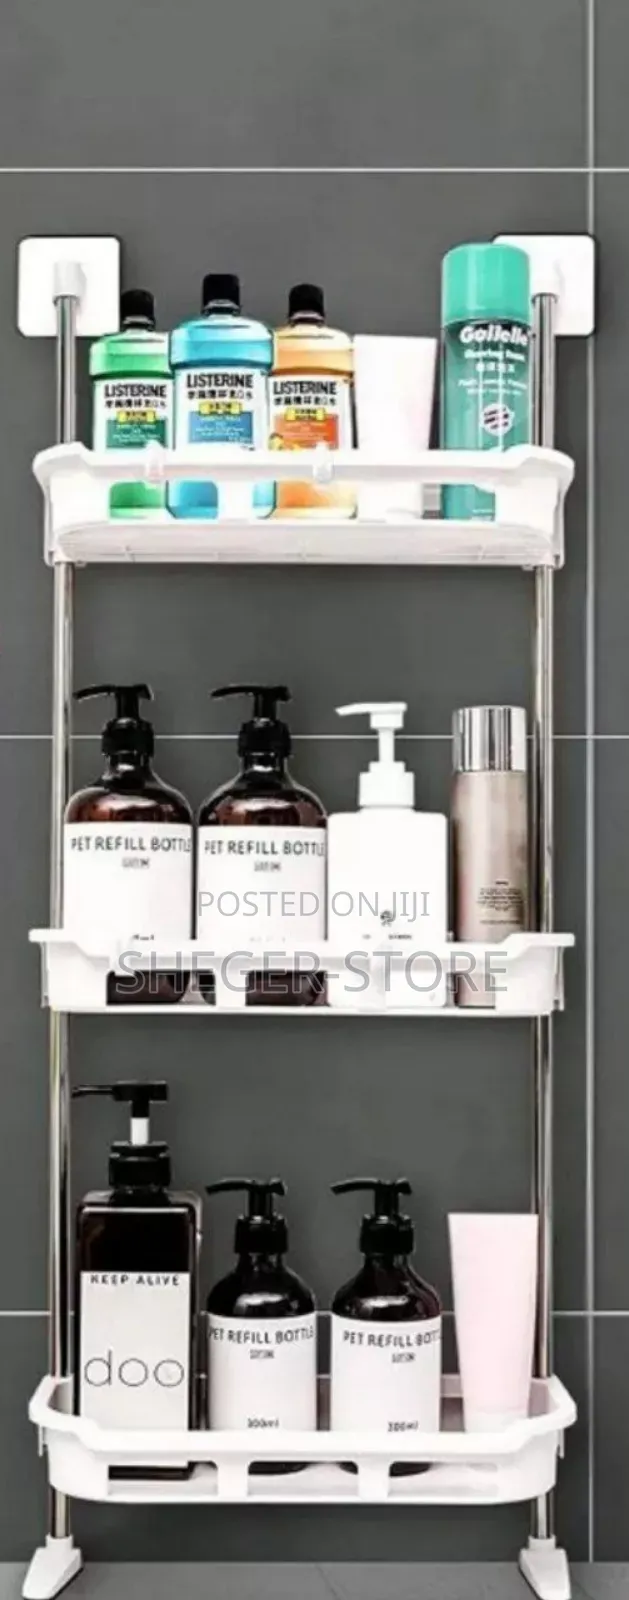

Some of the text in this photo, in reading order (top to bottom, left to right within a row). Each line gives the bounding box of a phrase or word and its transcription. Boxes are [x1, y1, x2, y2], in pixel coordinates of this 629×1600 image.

[187, 373, 253, 388] LISTERINE
[273, 380, 337, 395] LISTERINE
[104, 383, 167, 397] LISTERINE
[71, 836, 92, 851] PET
[95, 835, 146, 851] REFILL
[204, 840, 224, 855] PET
[227, 840, 278, 855] REFILL
[90, 1274, 180, 1286] KEEP ALIVE
[208, 1327, 224, 1341] PET
[227, 1329, 271, 1344] REFILL
[343, 1330, 364, 1345] PET
[367, 1333, 413, 1348] REFILL
[84, 1349, 185, 1388] doo
